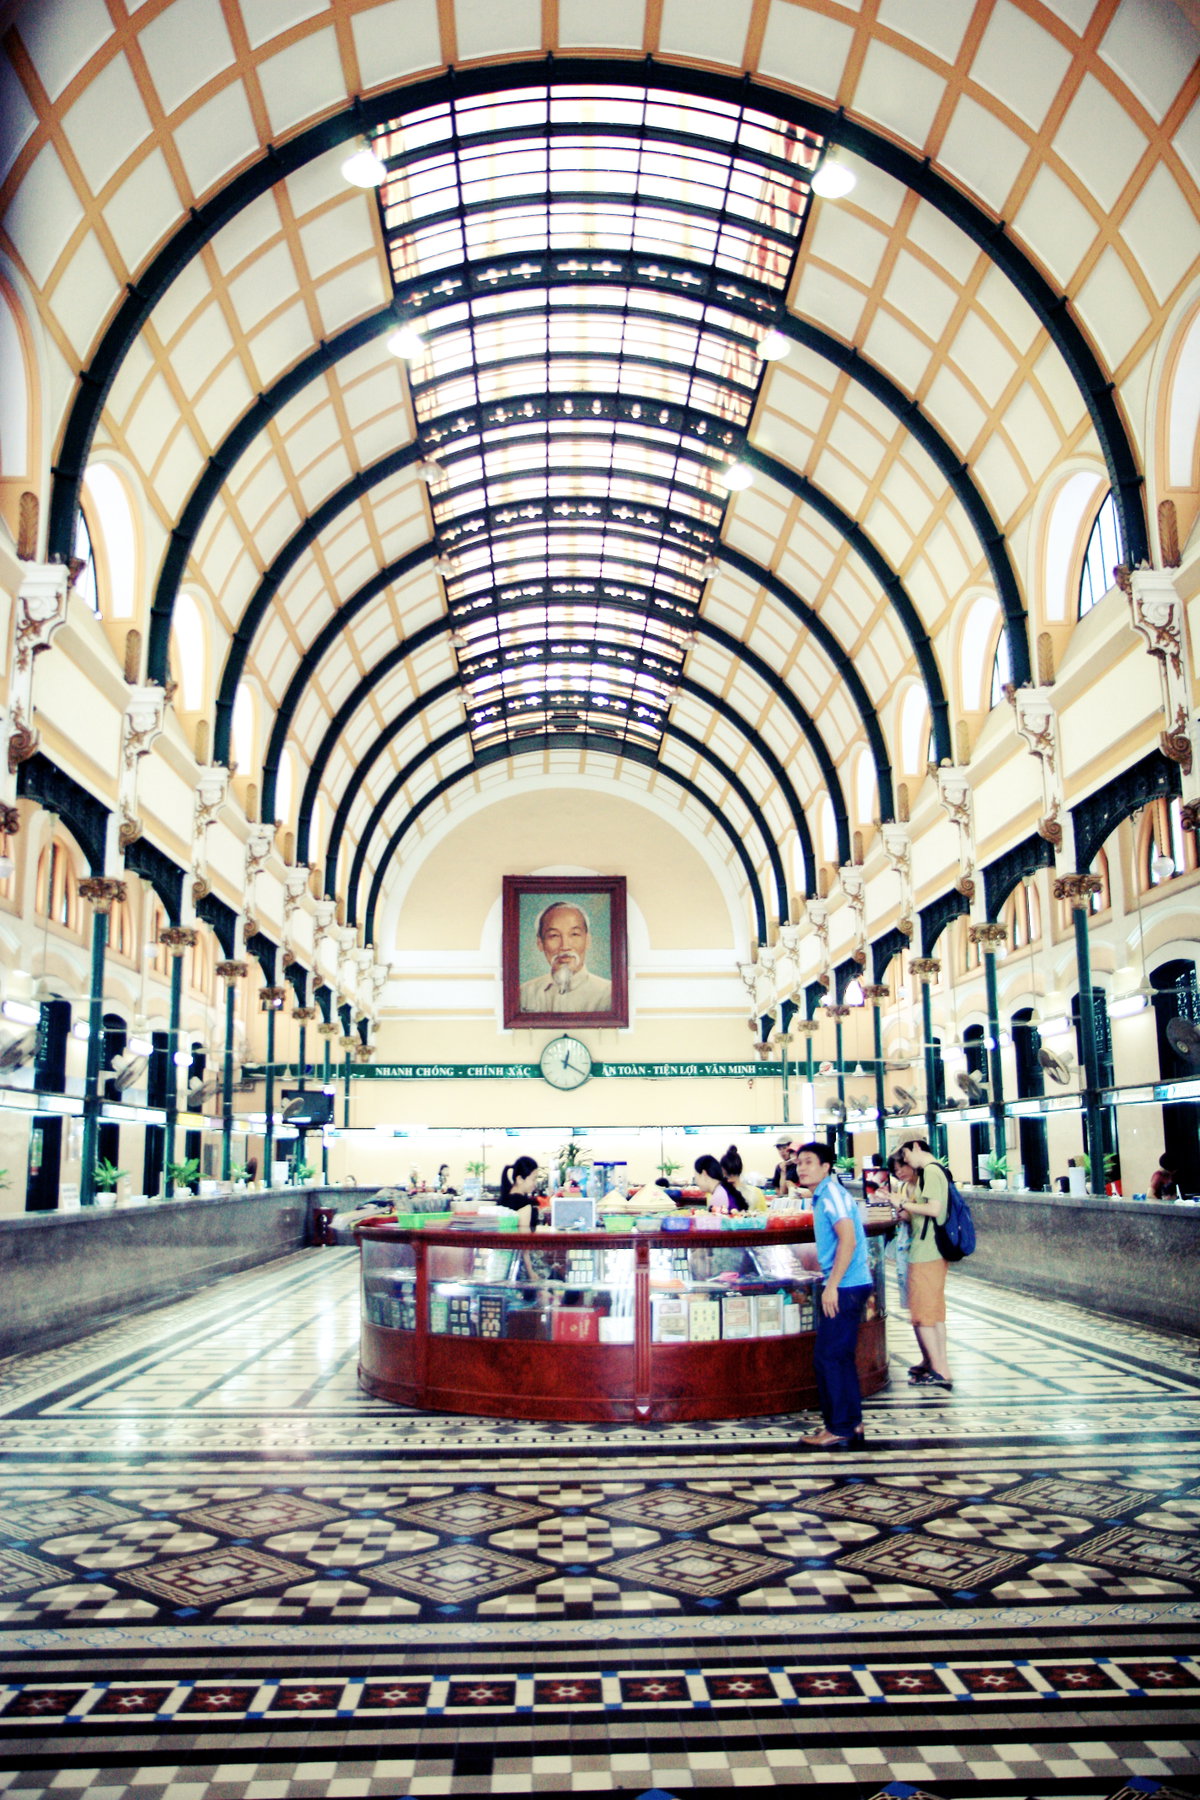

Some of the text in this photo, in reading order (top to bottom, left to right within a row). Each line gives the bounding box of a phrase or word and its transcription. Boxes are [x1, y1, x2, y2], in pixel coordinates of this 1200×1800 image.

[375, 1067, 413, 1076] NHANH
[415, 1065, 455, 1077] CHÓNG
[467, 1065, 504, 1076] CHÍNH
[617, 1063, 646, 1075] TOÀN
[704, 1063, 727, 1074] VĂN
[727, 1065, 757, 1074] MINH
